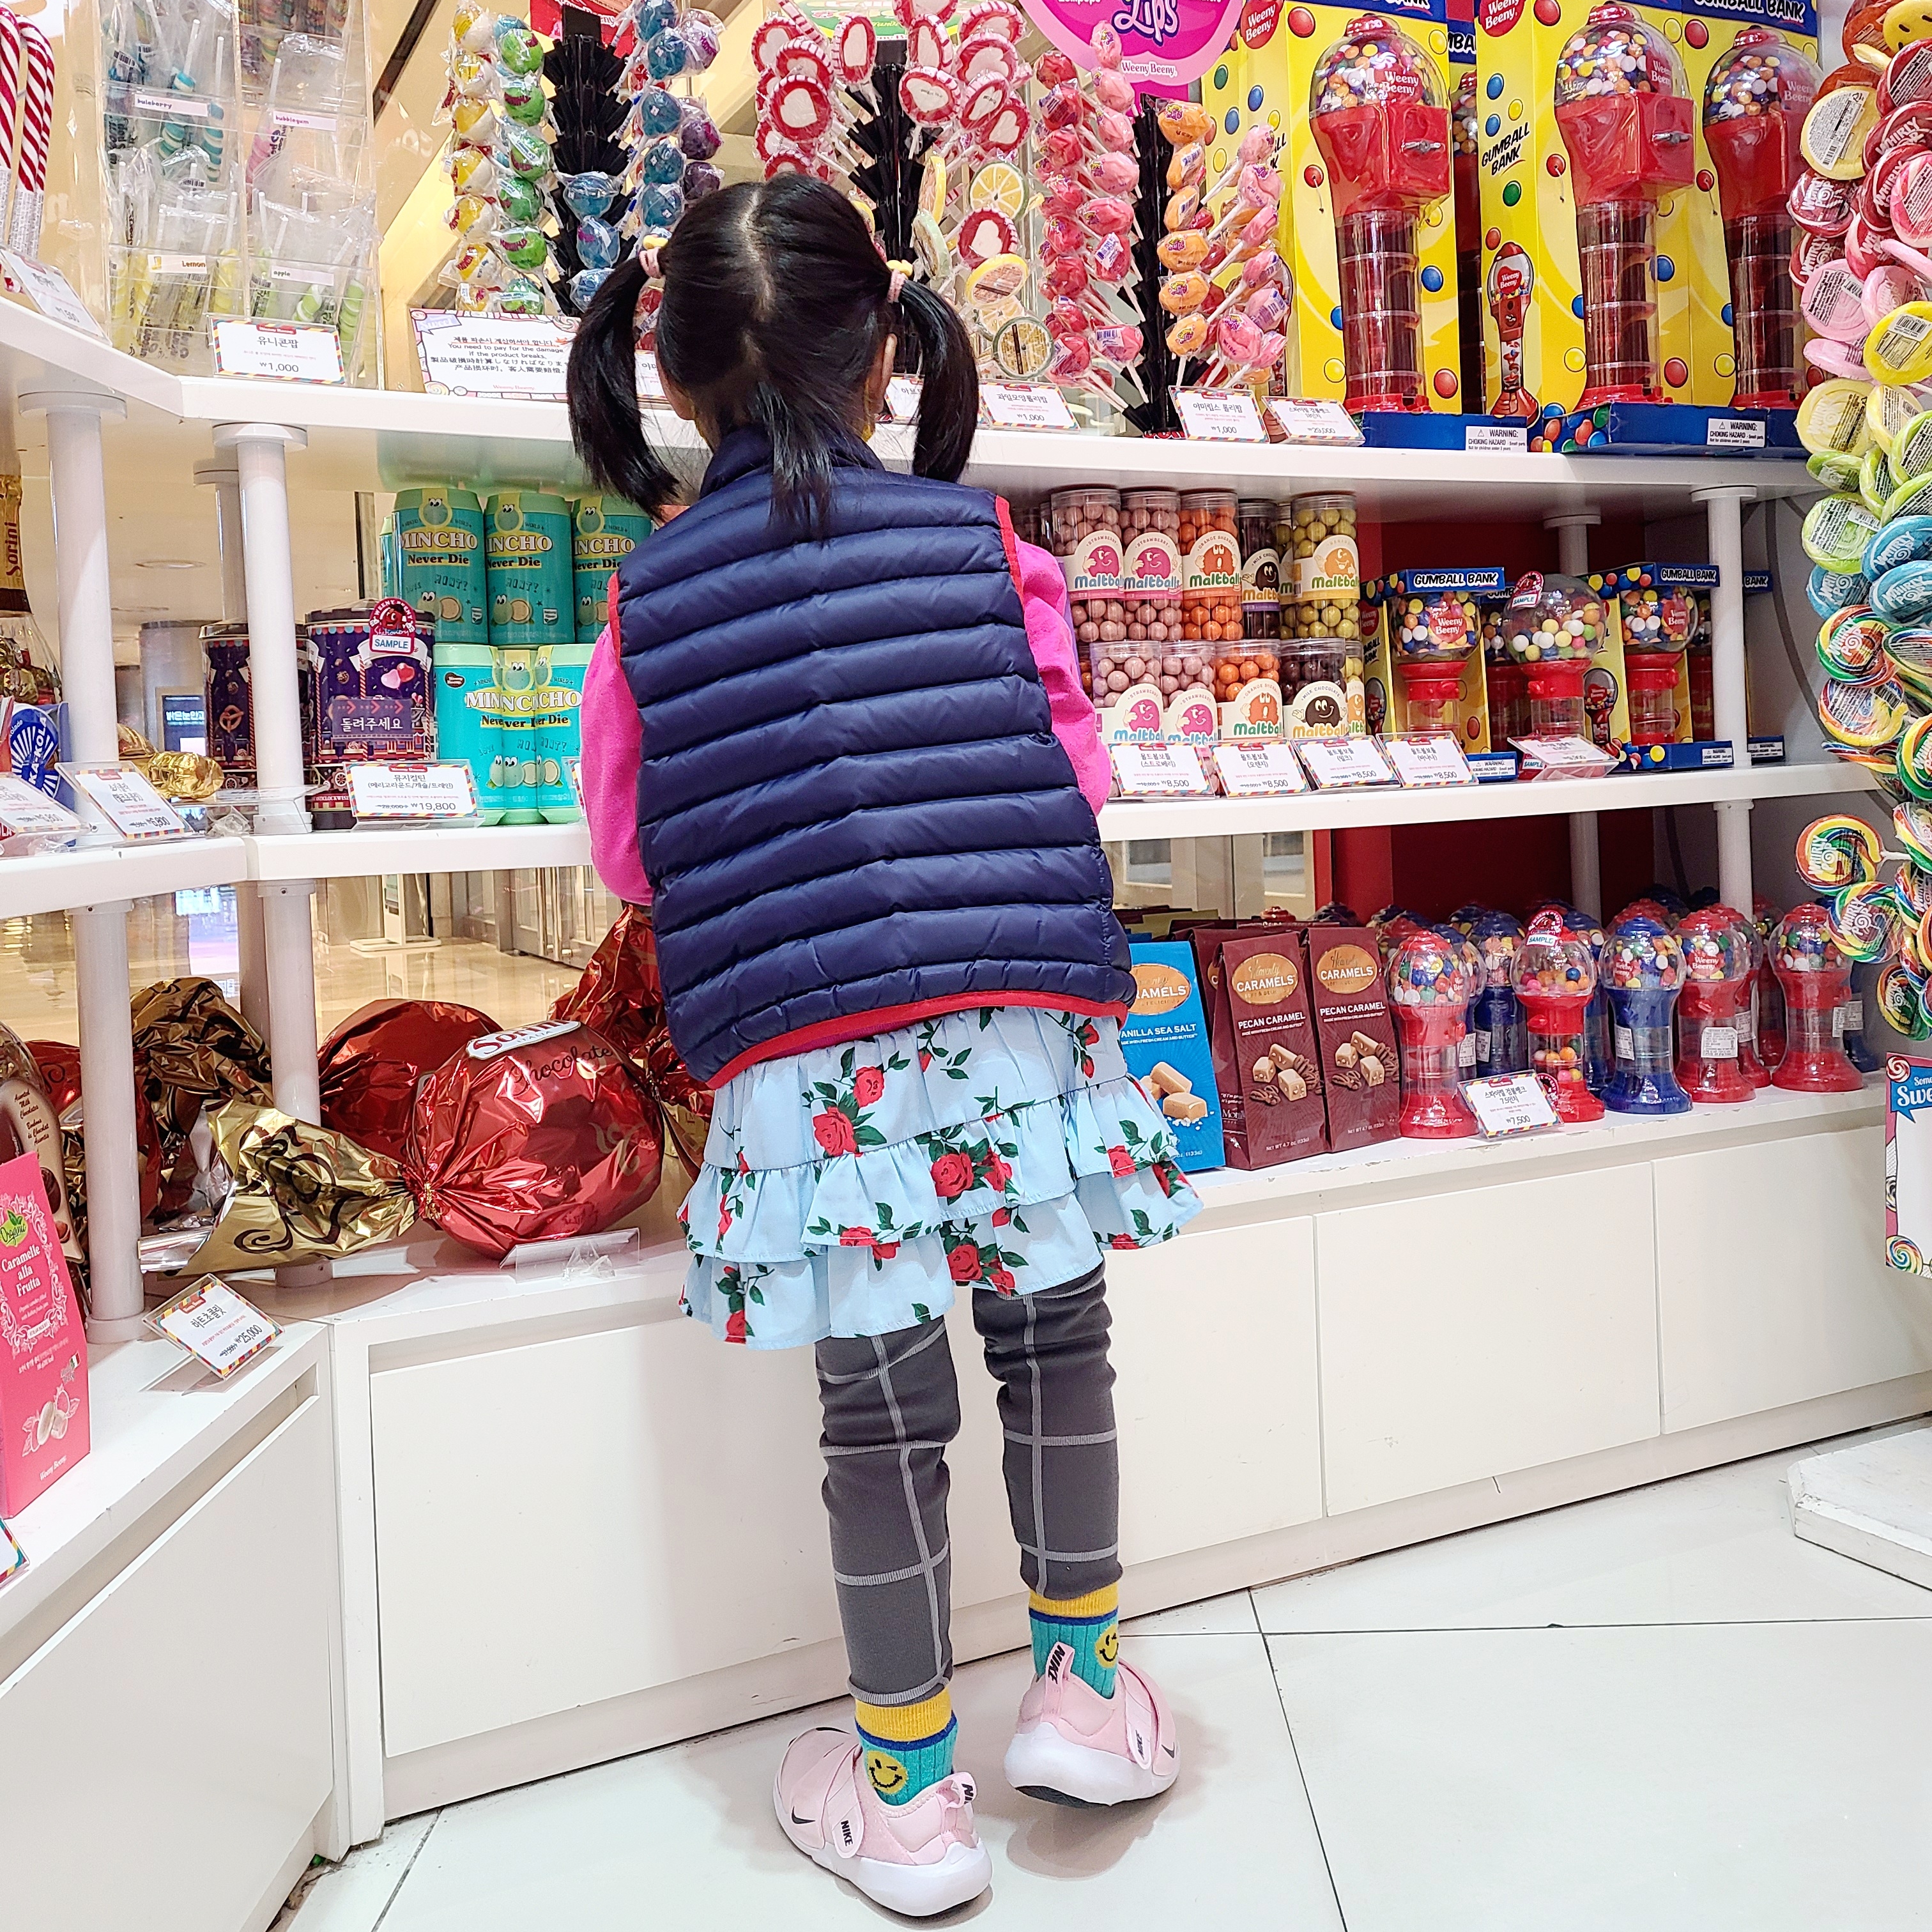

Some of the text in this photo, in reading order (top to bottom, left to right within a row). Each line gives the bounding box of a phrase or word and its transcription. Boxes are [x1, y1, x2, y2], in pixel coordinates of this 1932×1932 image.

[1248, 3, 1276, 24] Weeny
[1485, 8, 1517, 29] Beeny
[1767, 1, 1804, 21] BANK
[1245, 19, 1274, 40] Beeny
[1122, 62, 1174, 75] Weeny Beeny
[1384, 71, 1419, 86] Weeny
[1382, 82, 1415, 95] Beeny
[1875, 117, 1920, 155] WHIRLY
[1482, 122, 1529, 168] GUMBALL
[1492, 144, 1521, 176] BANK
[1873, 160, 1905, 206] WHIRLY
[1800, 234, 1827, 276] WHIRLY
[182, 260, 206, 268] Lemon
[1501, 272, 1520, 282] Weeny
[257, 336, 299, 349] 유니콘팝
[259, 362, 299, 373] ₩1,000
[1017, 413, 1045, 422] ₩1,000
[1211, 425, 1237, 434] ₩1,000
[1489, 429, 1519, 438] WARNING:
[1729, 421, 1756, 431] WARNING:
[4, 521, 20, 576] Sorini
[401, 532, 479, 550] MINCHO
[486, 536, 553, 553] INCHO
[1136, 535, 1170, 550] STRAWBERRY
[1873, 531, 1916, 569] WHIRLY
[408, 553, 470, 565] Never Die
[519, 556, 541, 567] Die
[1414, 572, 1497, 586] GUMBALL BANK
[1661, 568, 1716, 581] GUMBALL BANK
[1745, 574, 1768, 586] BANK
[1884, 576, 1925, 604] WHIRLY
[374, 600, 395, 616] WEENY
[1514, 597, 1535, 605] SAMPLE
[1436, 624, 1462, 635] Beeny
[1438, 617, 1464, 629] Weeny
[375, 638, 409, 649] SAMPLE
[1827, 617, 1855, 657] WHIRLY
[1841, 627, 1863, 657] POP
[1301, 689, 1312, 701] MILK
[341, 717, 403, 733] 돌려주세요
[548, 714, 569, 724] Die
[1351, 770, 1377, 779] ₩8,500
[1434, 770, 1457, 779] ₩8,500
[1161, 779, 1190, 788] ₩8,500
[1262, 779, 1289, 788] ₩8,500
[411, 802, 456, 811] ₩19,800
[1808, 834, 1828, 875] WHIRLY
[1821, 841, 1837, 871] POP
[1837, 898, 1867, 937] WHIRLY
[1852, 907, 1875, 936] POP
[1692, 962, 1715, 971] Beeny
[1694, 955, 1719, 965] Weeny
[1320, 965, 1374, 981] CARAMELS
[1236, 974, 1294, 993] CARAMELS
[1135, 985, 1187, 1000] RAMELS
[1319, 1001, 1386, 1017] PECAN CARAMEL
[1238, 1011, 1307, 1030] PECAN CARAMEL
[1154, 1026, 1173, 1036] SEA
[1174, 1023, 1197, 1033] SALT
[1506, 1115, 1531, 1126] ₩7,500
[1, 1223, 27, 1245] Organic
[1, 1244, 41, 1272] Caramelle
[17, 1264, 33, 1281] alla
[15, 1276, 41, 1298] Frutta
[235, 1324, 263, 1344] ₩25,000
[1048, 1644, 1066, 1685] NIKE
[841, 1820, 855, 1847] NIKE
